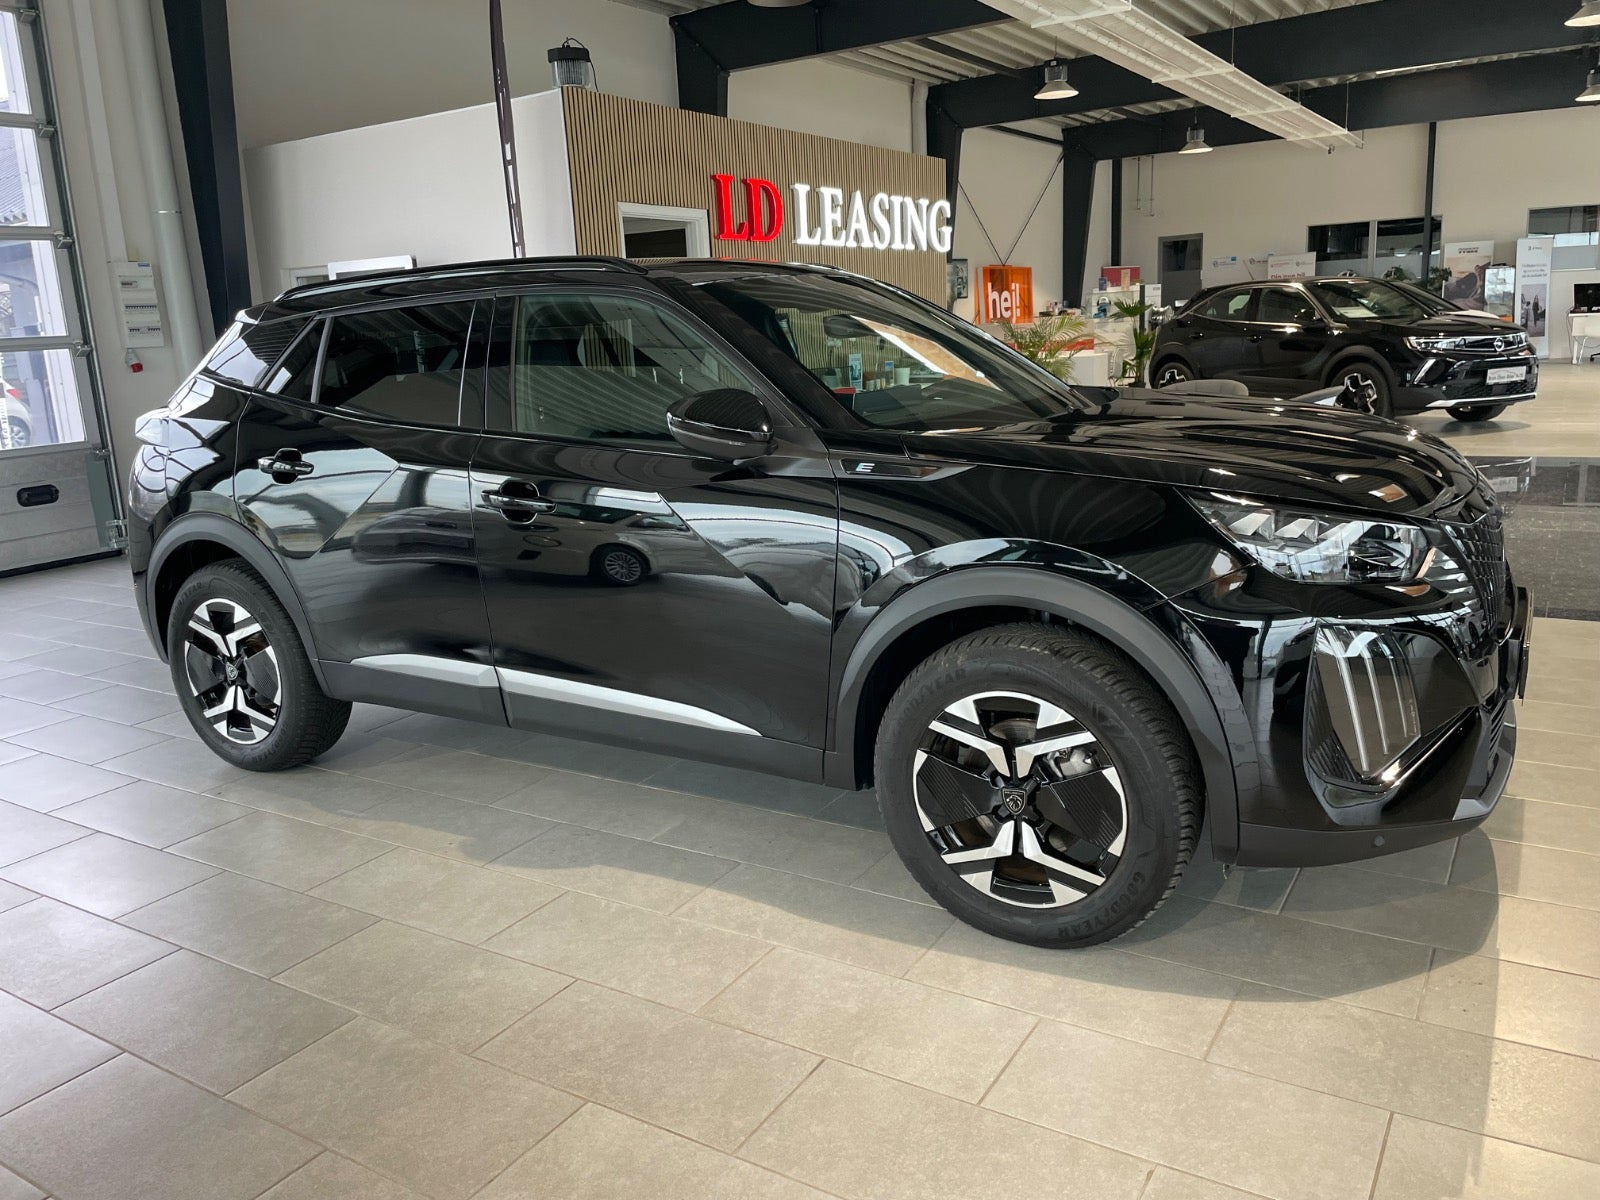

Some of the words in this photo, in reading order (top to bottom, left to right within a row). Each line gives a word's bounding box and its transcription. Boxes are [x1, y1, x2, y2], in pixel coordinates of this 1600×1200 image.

[711, 173, 784, 242] LD
[790, 183, 953, 253] LEASING
[987, 282, 1021, 324] hej!
[1057, 871, 1145, 938] GOODYEAR
